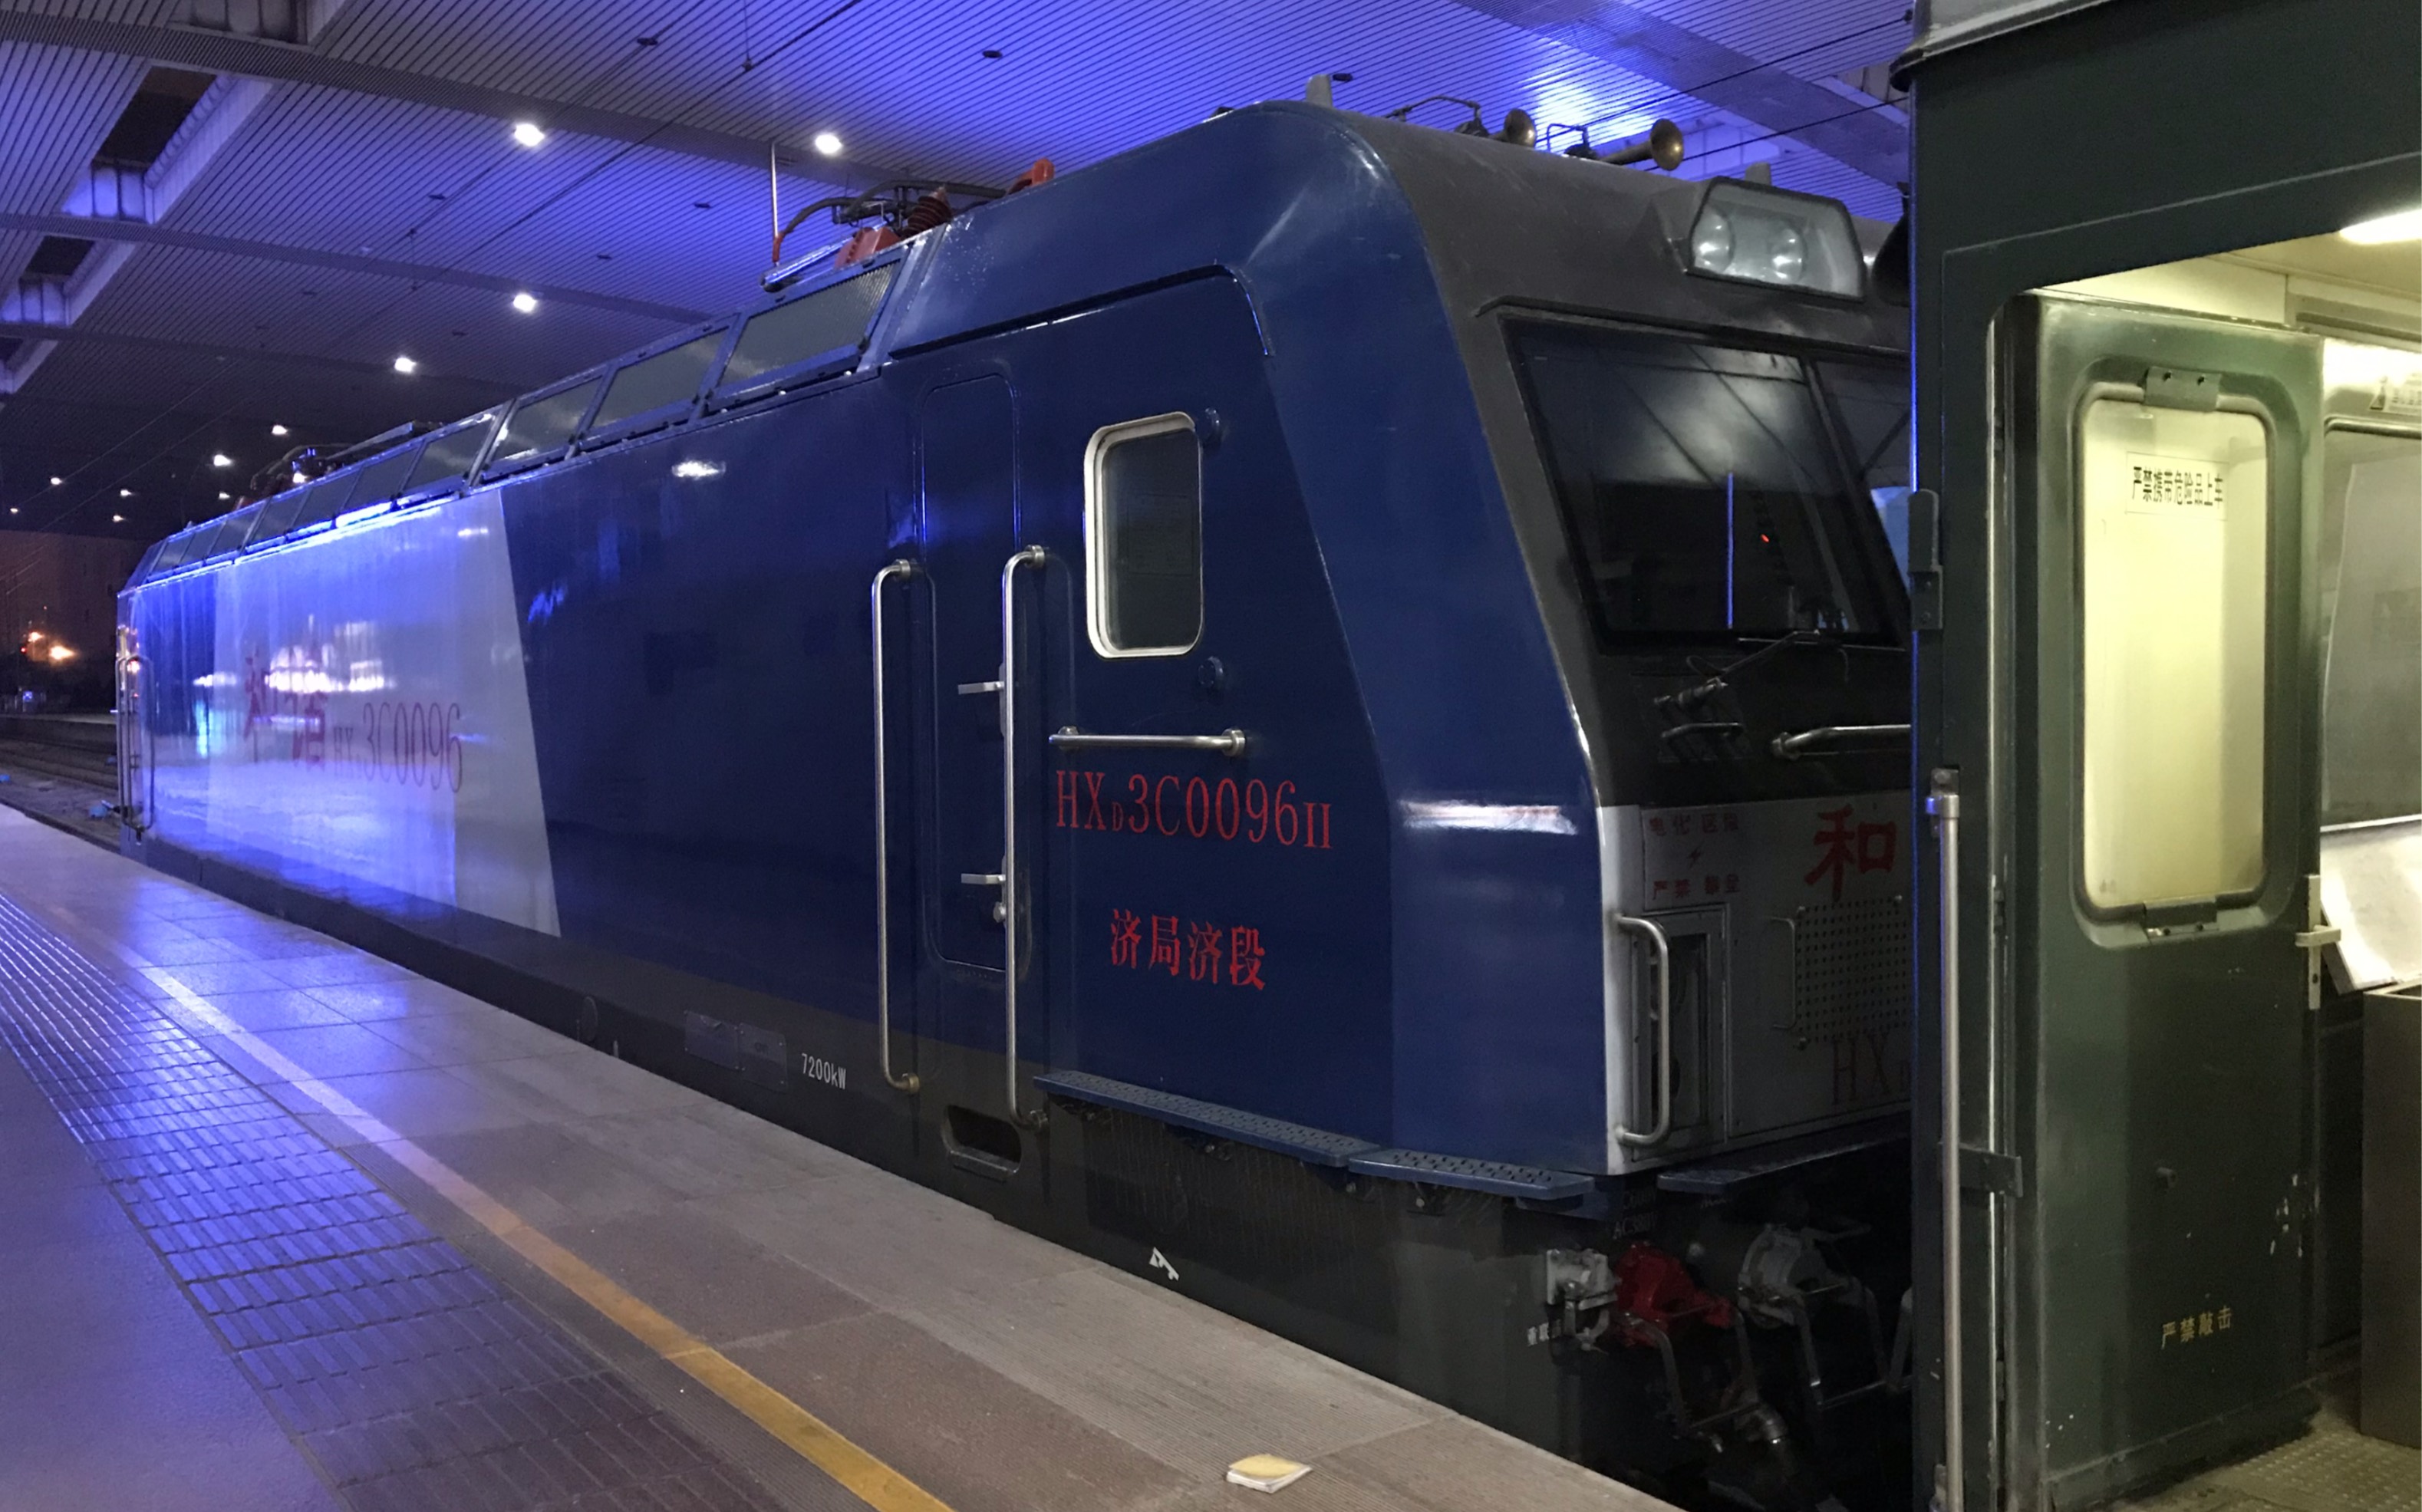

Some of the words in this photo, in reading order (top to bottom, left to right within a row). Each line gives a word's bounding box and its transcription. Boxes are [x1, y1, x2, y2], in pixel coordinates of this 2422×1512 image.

[1804, 802, 1898, 903] 和
[1110, 908, 1265, 990] 济局济段
[801, 1052, 846, 1089] 7200kW
[2161, 1305, 2233, 1350] 严禁敲击
